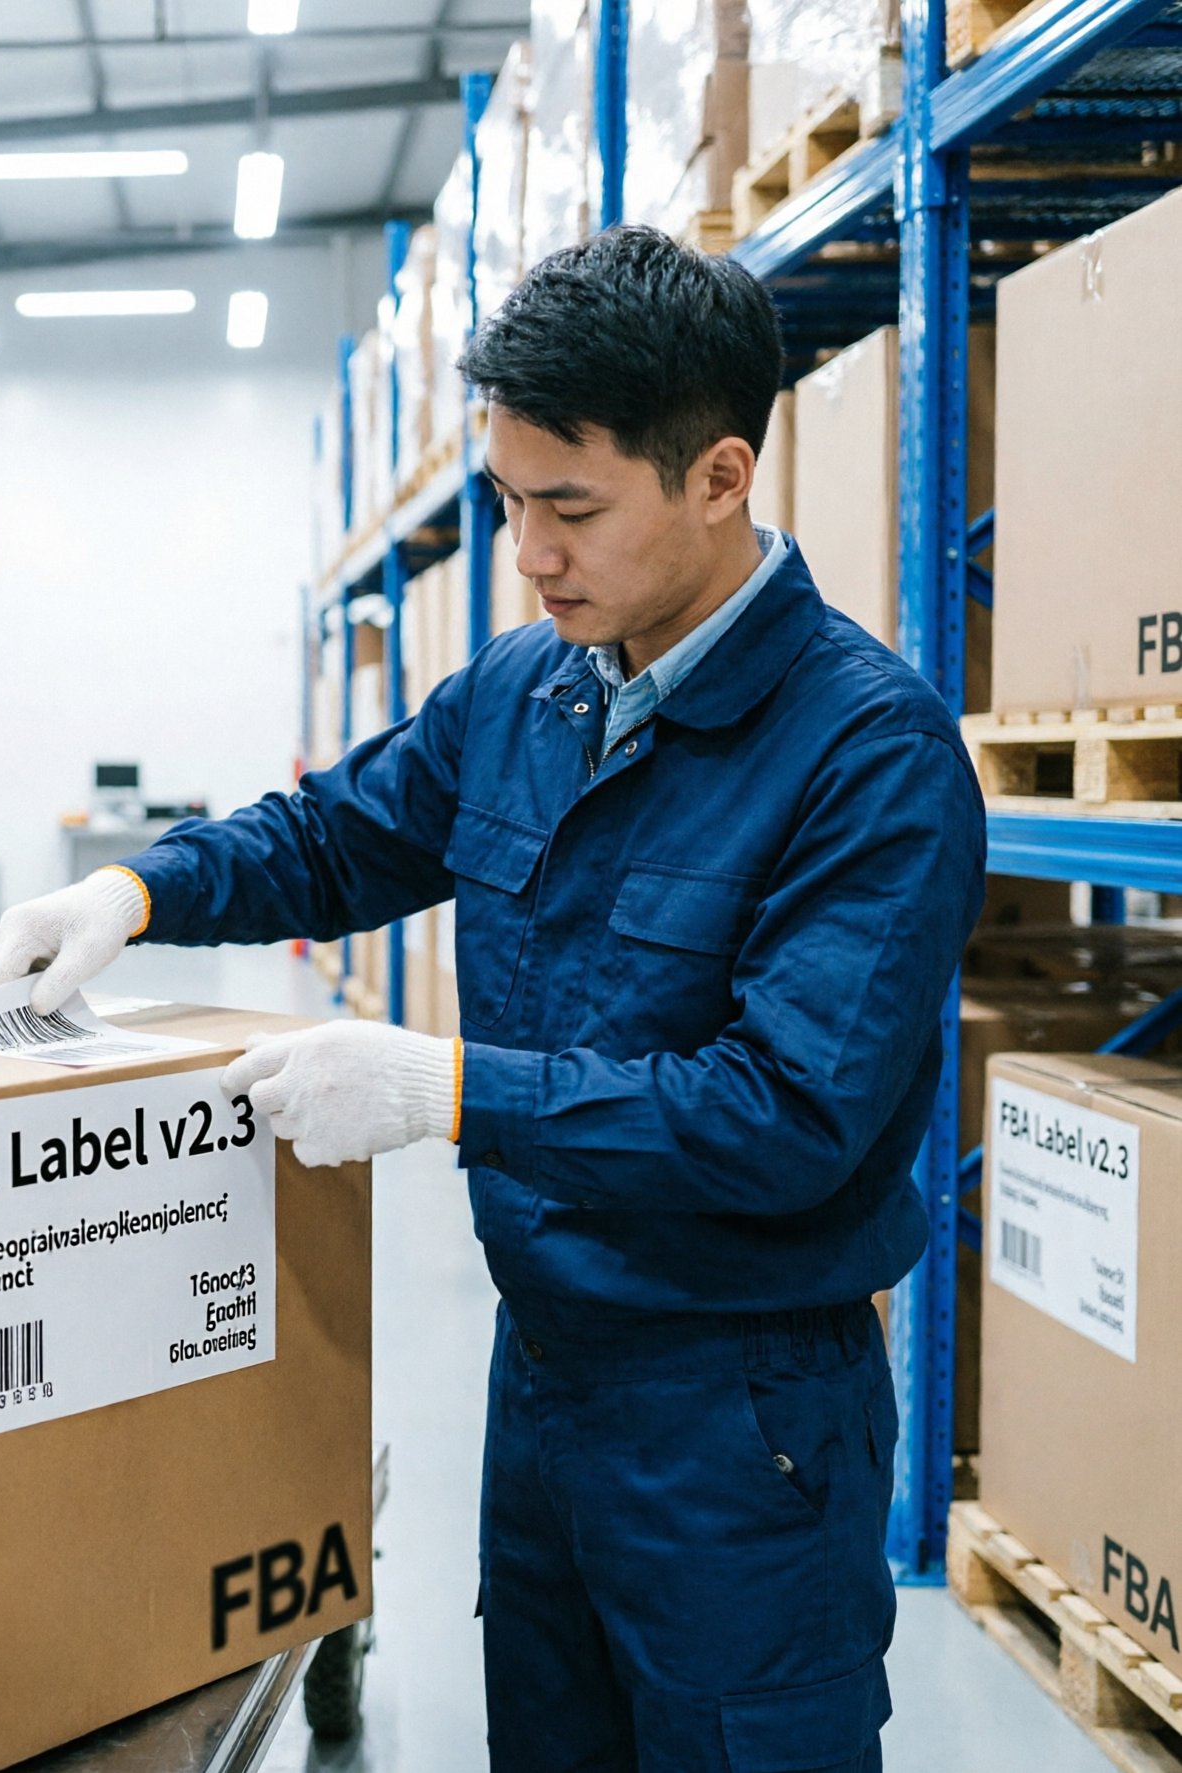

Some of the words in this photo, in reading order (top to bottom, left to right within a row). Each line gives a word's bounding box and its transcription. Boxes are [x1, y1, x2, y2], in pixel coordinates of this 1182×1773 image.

[11, 1107, 149, 1188] Label
[159, 1094, 256, 1160] v2.3
[1000, 1102, 1031, 1143] FBA
[1034, 1113, 1083, 1164] Label
[1087, 1136, 1129, 1180] v2.3
[210, 1520, 359, 1652] FBA
[1102, 1532, 1181, 1654] FBA
